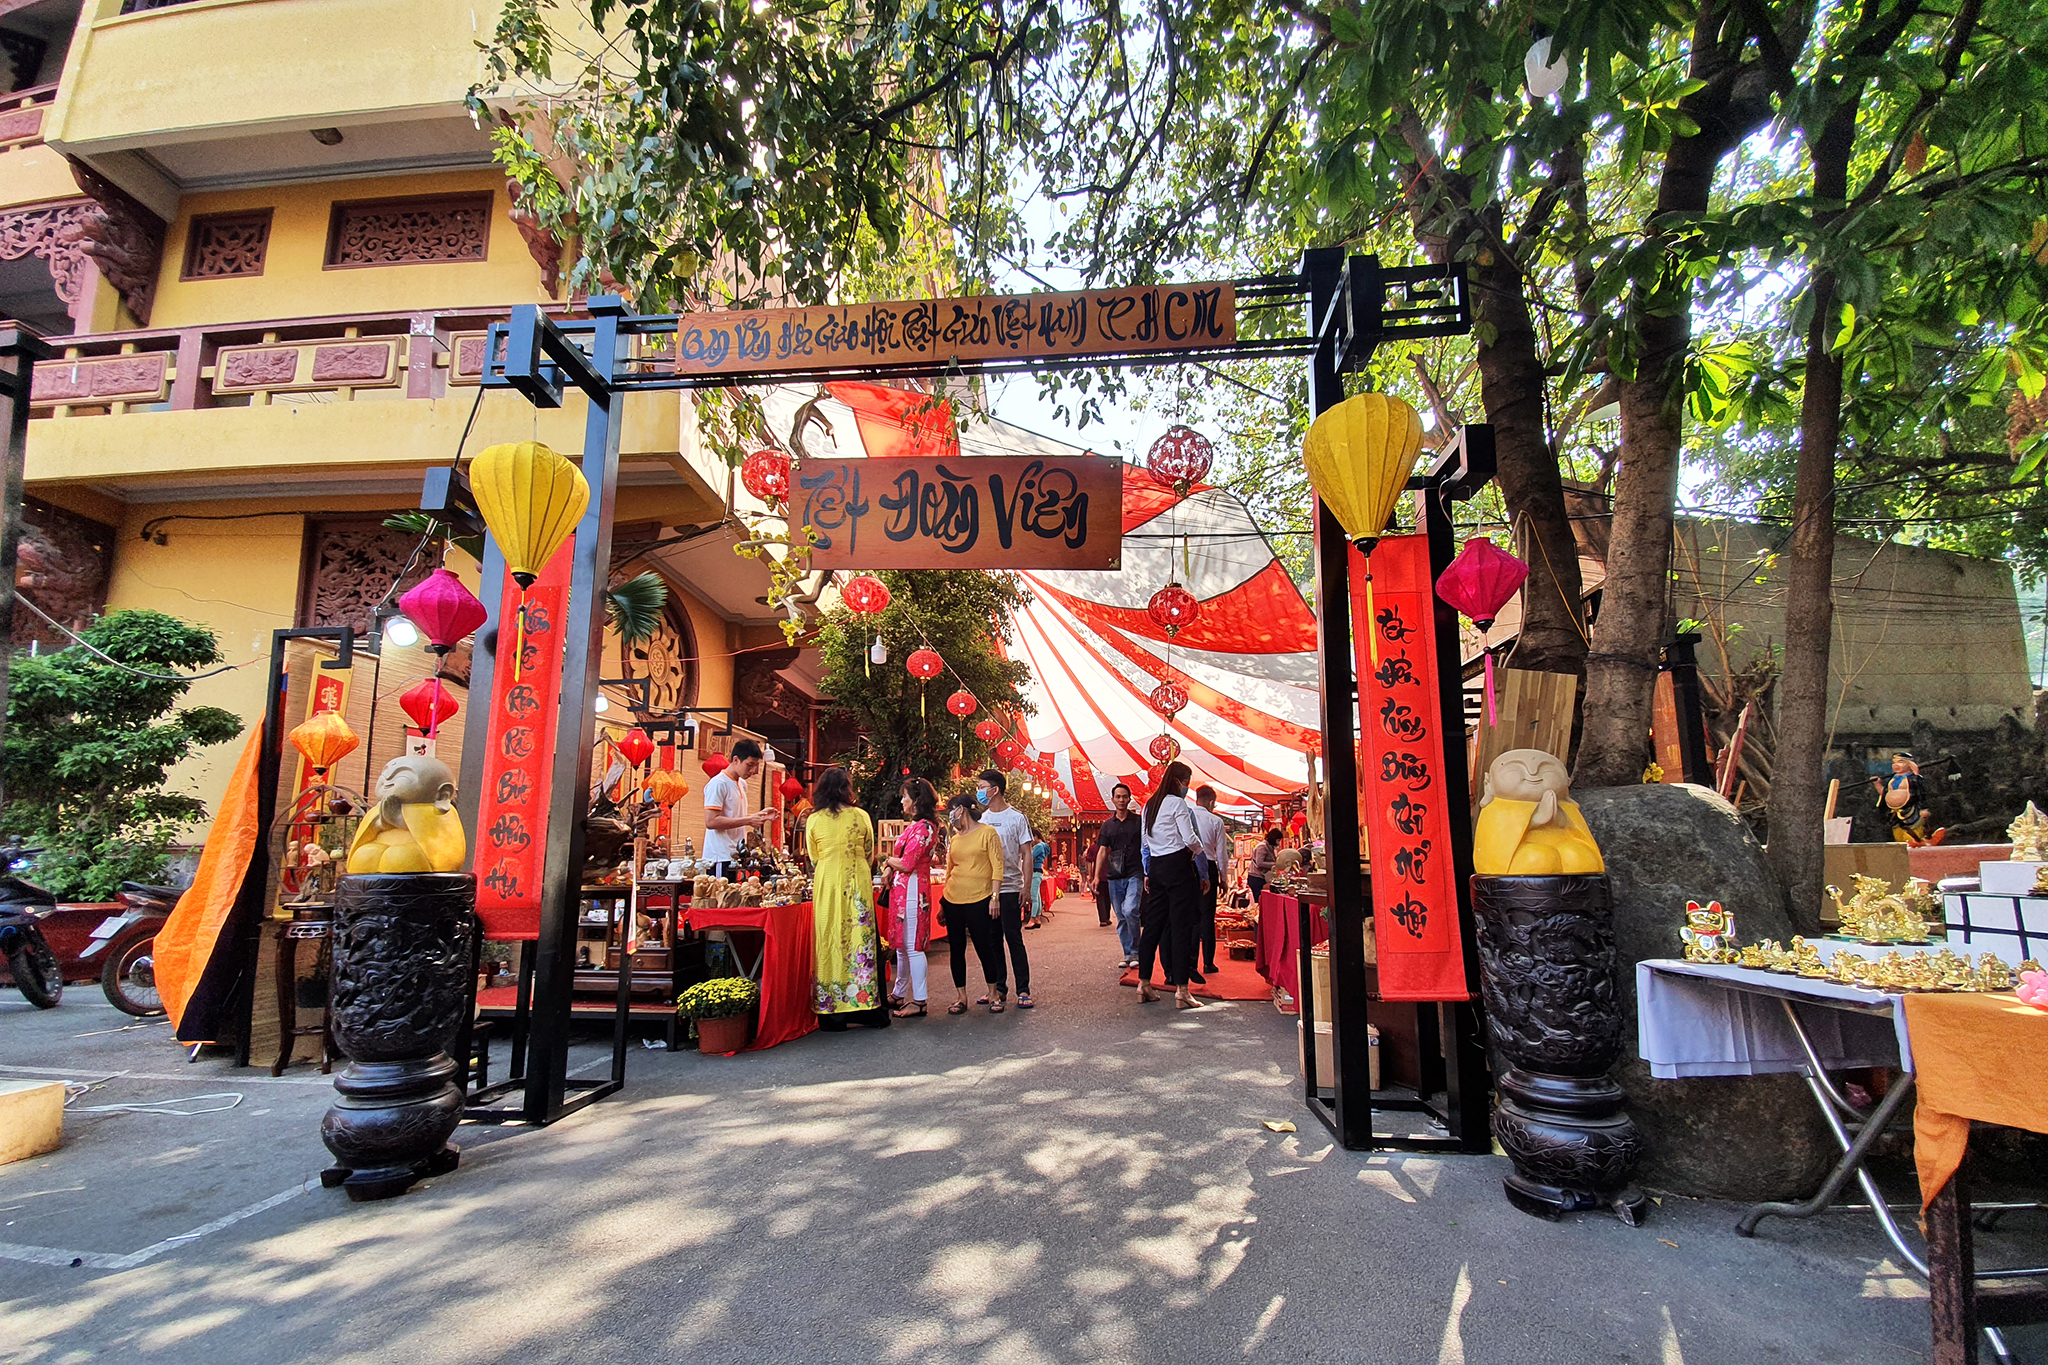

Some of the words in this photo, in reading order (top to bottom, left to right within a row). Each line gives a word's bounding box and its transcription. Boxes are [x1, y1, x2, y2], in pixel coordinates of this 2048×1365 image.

[815, 308, 859, 354] Giáo
[861, 305, 900, 355] Hội
[901, 302, 942, 359] Phật
[942, 300, 990, 348] Giáo
[991, 298, 1037, 353] Việt
[1038, 296, 1087, 347] Nam
[800, 464, 869, 556] Tết
[879, 464, 979, 554] Đoàn
[989, 460, 1089, 550] Viên
